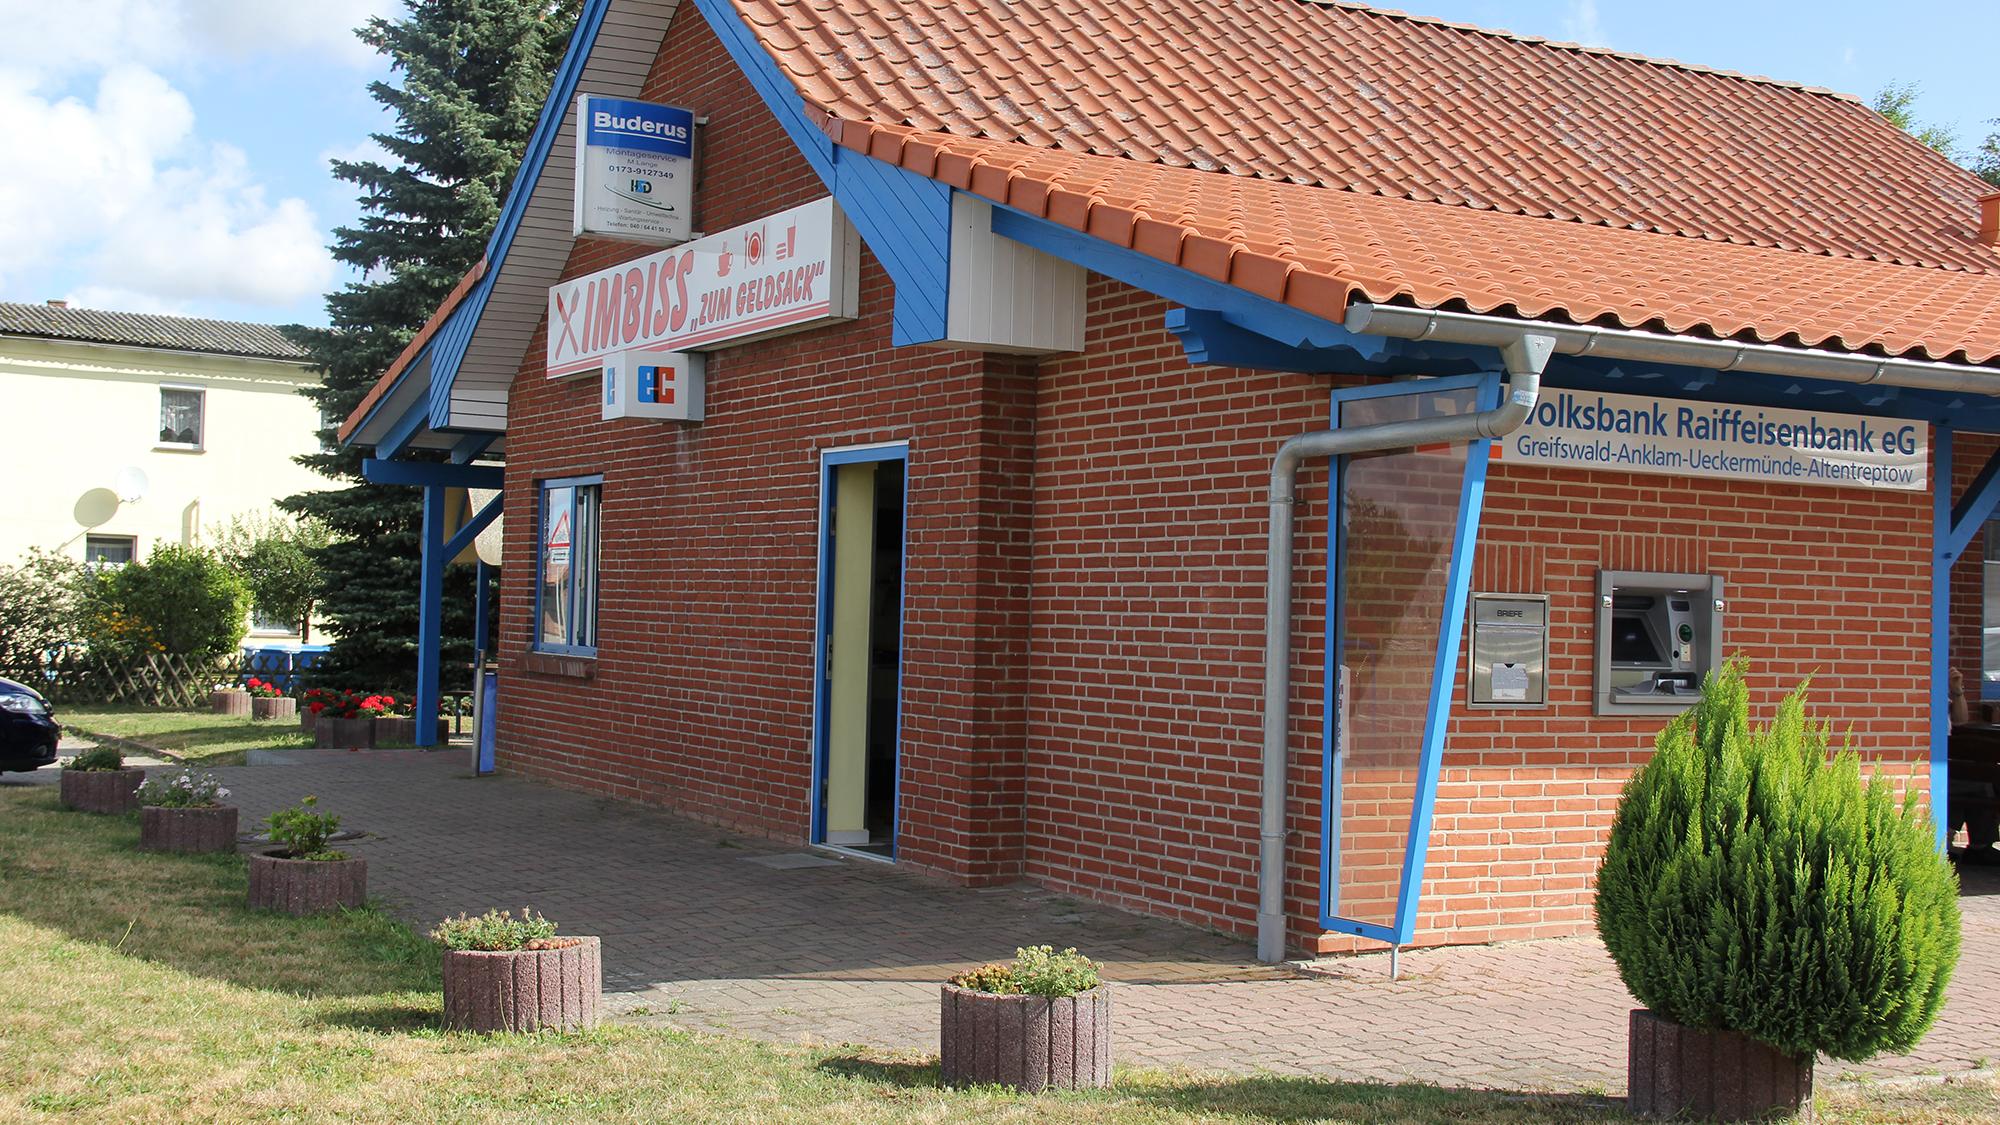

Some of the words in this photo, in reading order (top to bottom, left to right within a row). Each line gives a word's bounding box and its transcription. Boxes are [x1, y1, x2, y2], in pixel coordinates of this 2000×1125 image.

[594, 111, 687, 139] Buderus
[606, 148, 677, 164] Montageservice
[608, 165, 674, 179] 0173-9127349
[581, 249, 694, 354] IMBISS
[1677, 407, 1875, 453] Raiffeisenbank
[1881, 426, 1916, 456] eG
[1517, 435, 1913, 486] Greifswald-Anklam-Ueckermünde-Altentreptow
[1496, 609, 1523, 618] BRIEFE
